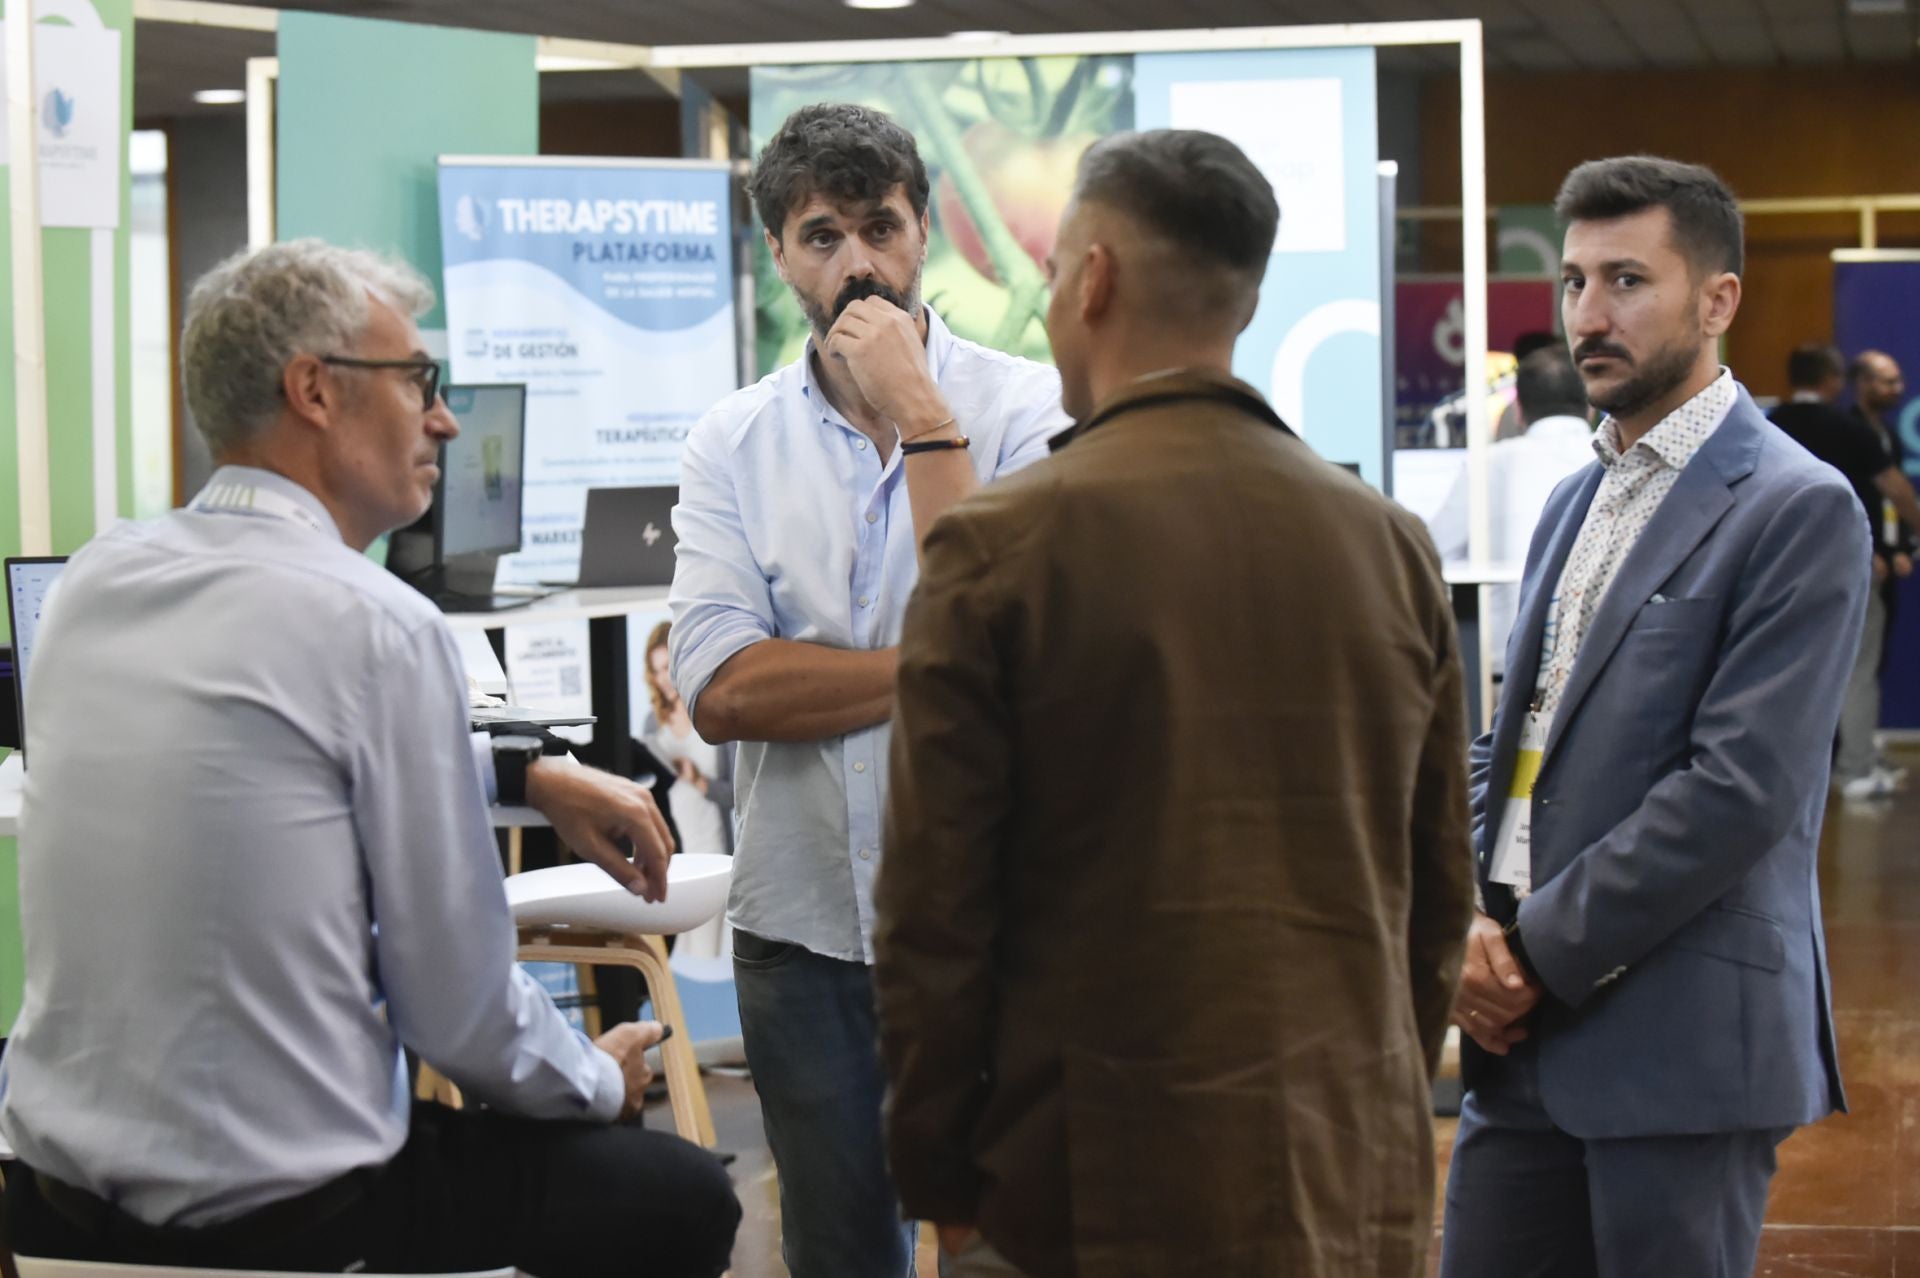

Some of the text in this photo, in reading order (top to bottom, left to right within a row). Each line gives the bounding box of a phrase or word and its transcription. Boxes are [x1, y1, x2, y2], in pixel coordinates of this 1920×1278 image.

[496, 198, 718, 235] THERAPSYTIME
[572, 242, 716, 263] PLATAFORMA
[493, 340, 579, 359] DE GESTIÓN
